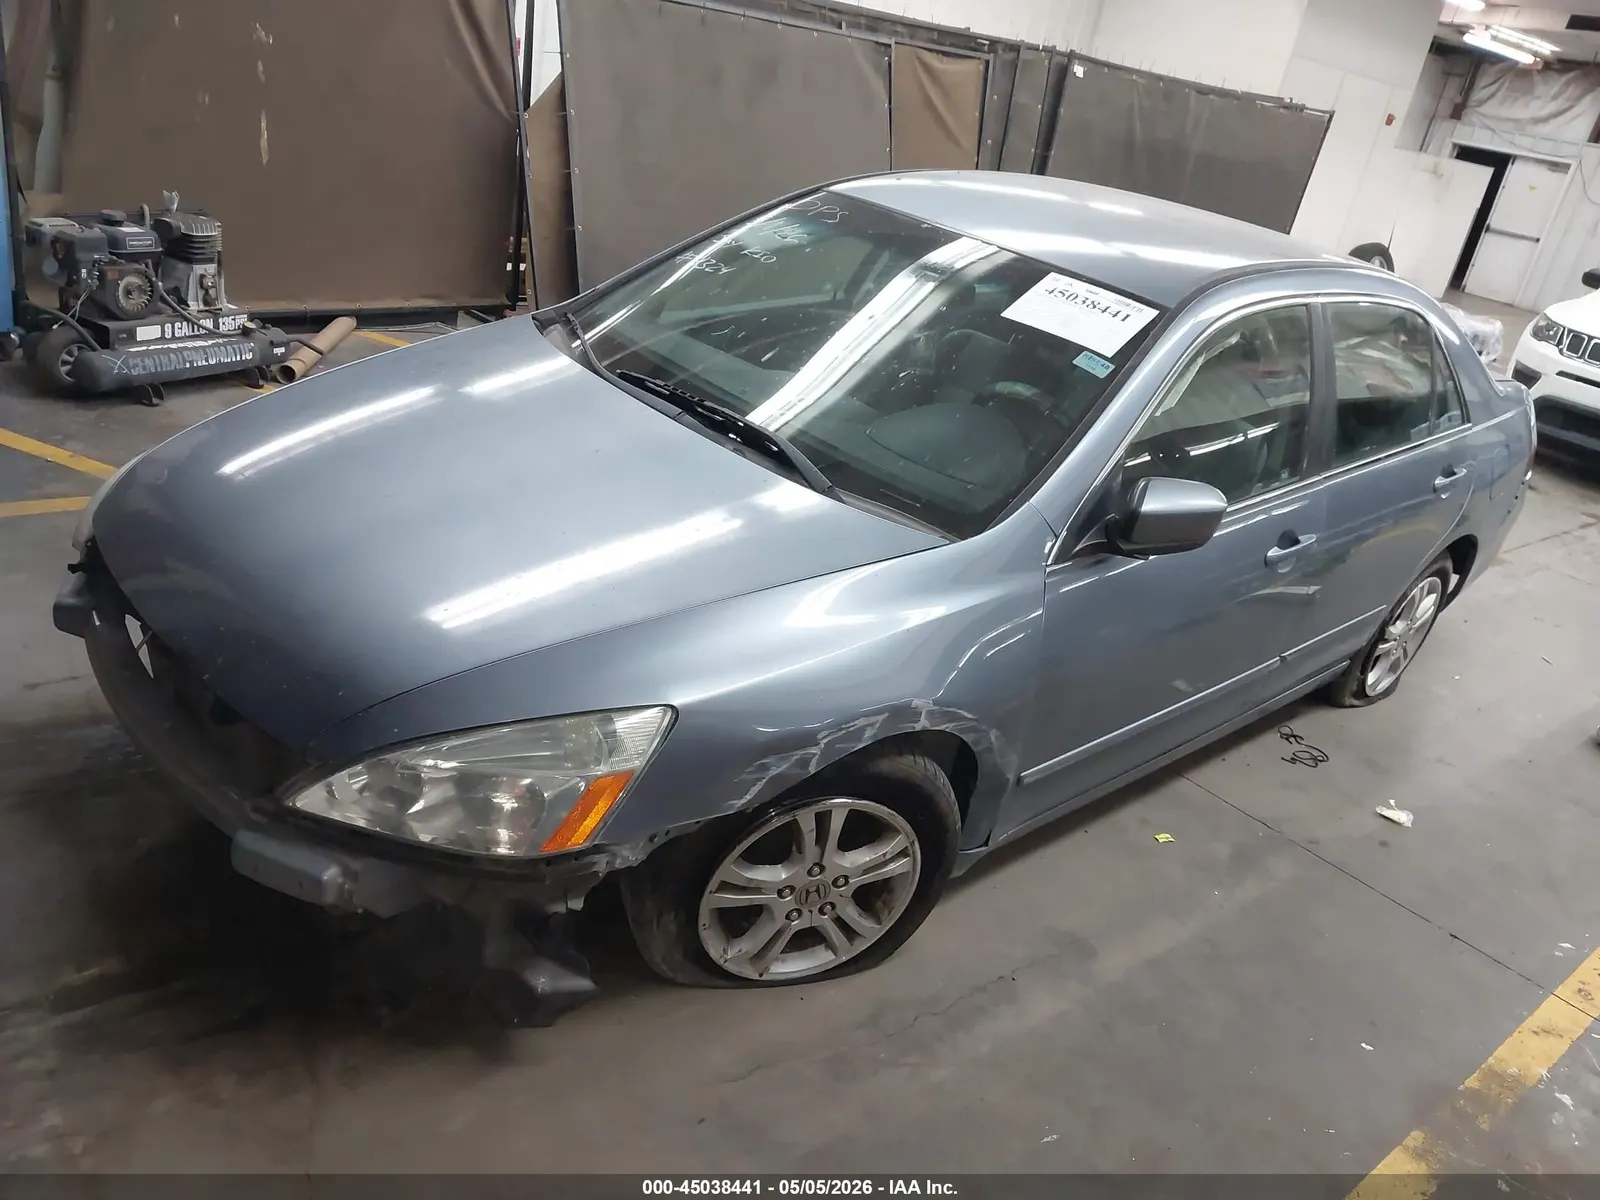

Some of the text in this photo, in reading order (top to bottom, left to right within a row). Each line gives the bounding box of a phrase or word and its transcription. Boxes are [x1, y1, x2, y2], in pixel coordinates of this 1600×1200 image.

[788, 199, 850, 223] DPS
[1044, 286, 1132, 323] 45038441
[174, 317, 214, 337] GALLON
[218, 315, 235, 332] 135
[130, 351, 185, 376] CENTRAL
